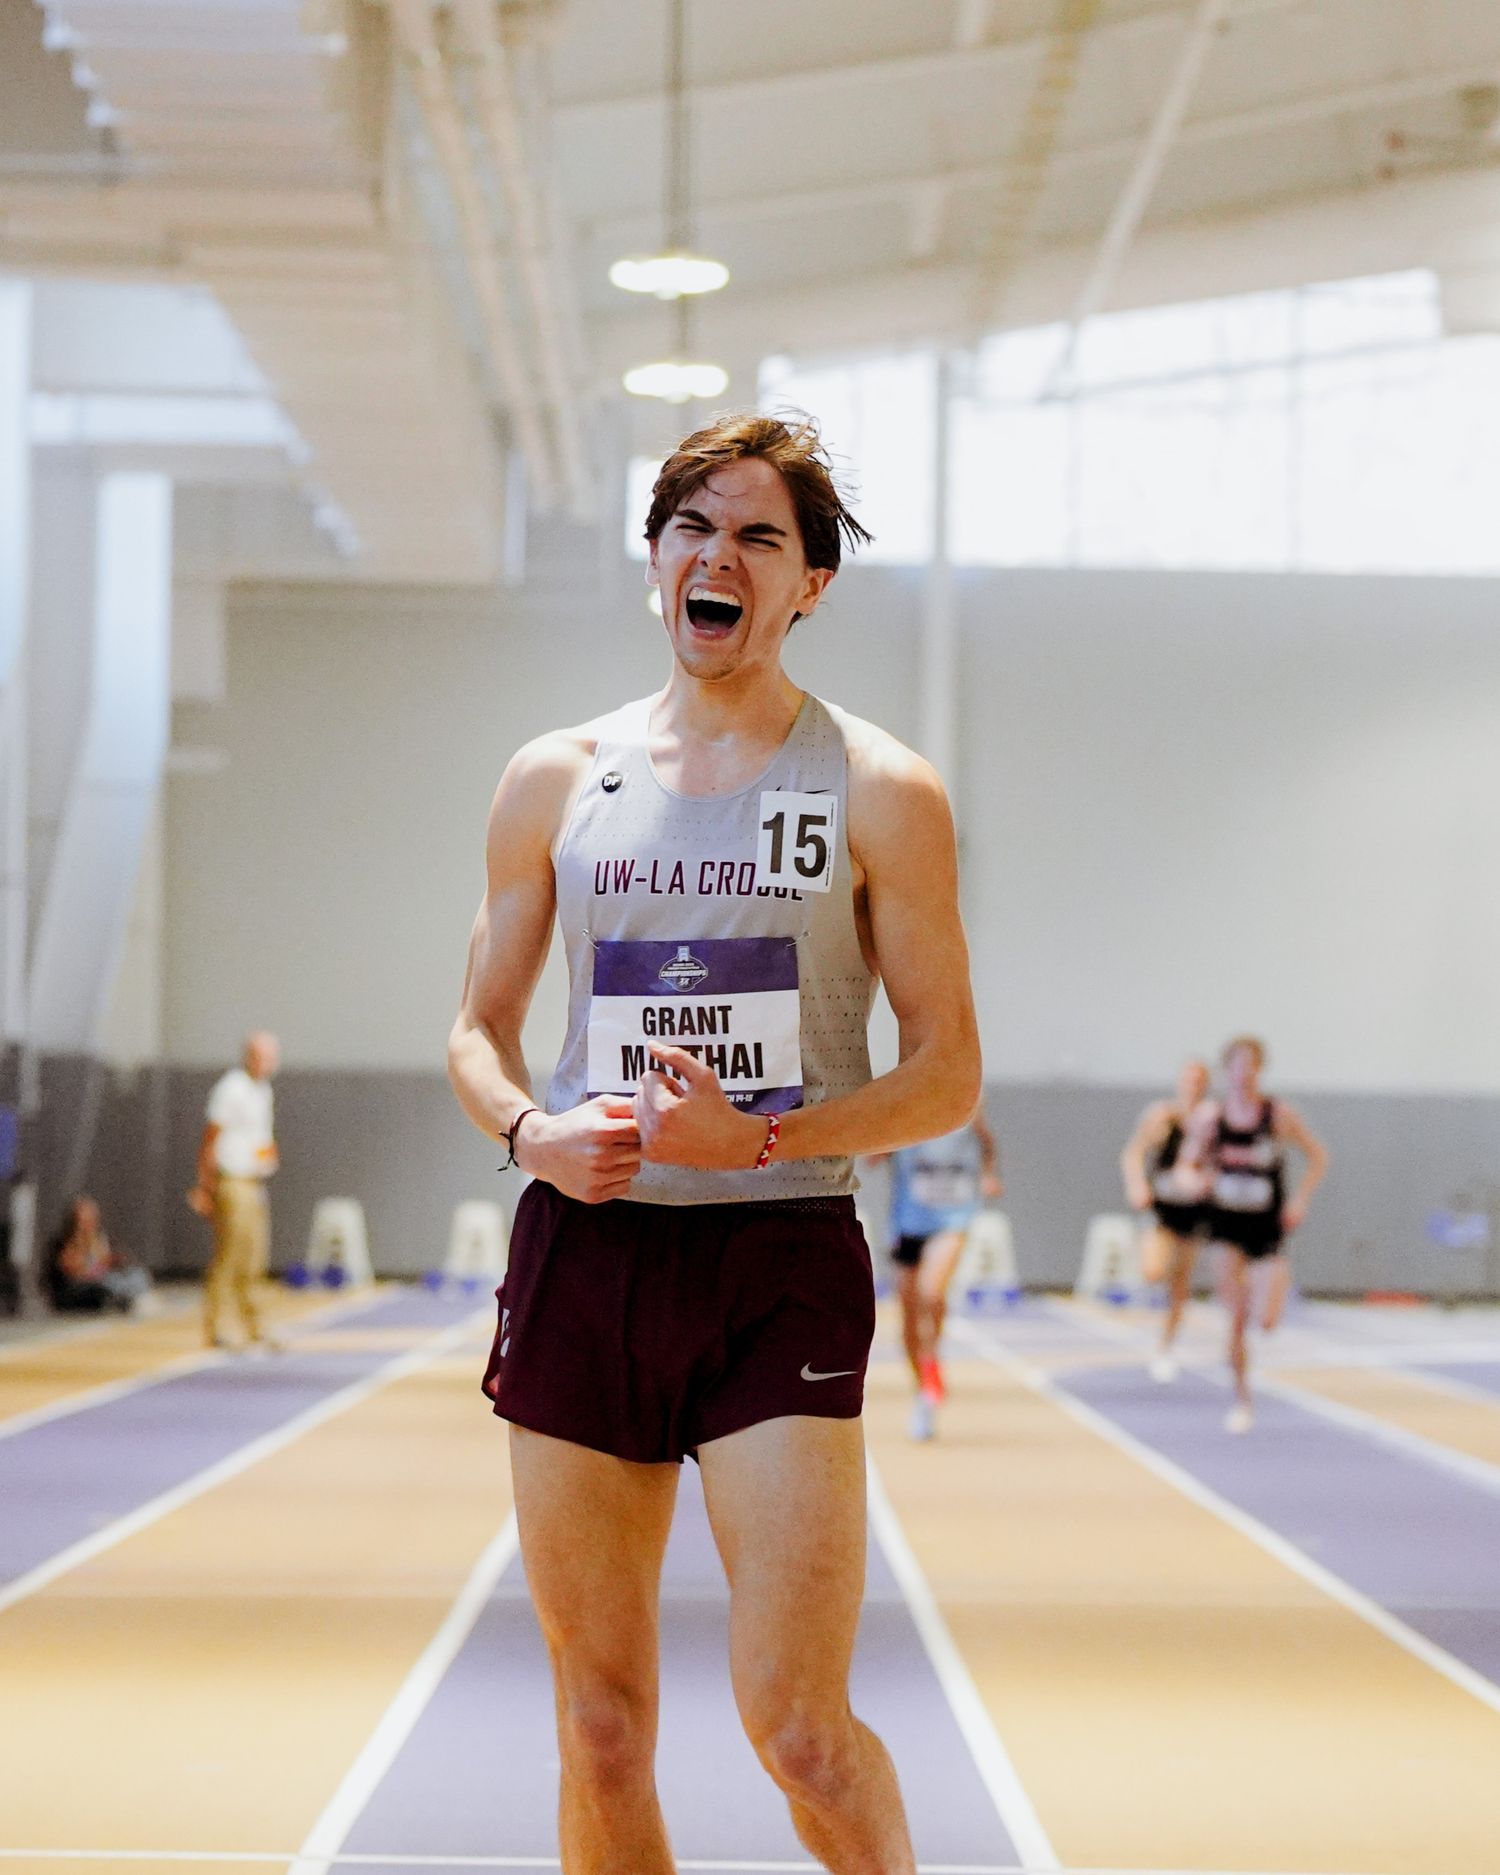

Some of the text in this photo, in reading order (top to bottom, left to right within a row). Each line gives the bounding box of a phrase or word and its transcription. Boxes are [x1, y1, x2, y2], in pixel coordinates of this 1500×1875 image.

[603, 775, 622, 787] DF
[762, 811, 827, 878] 15
[594, 859, 685, 895] UW-LA
[642, 1005, 733, 1036] GRANT
